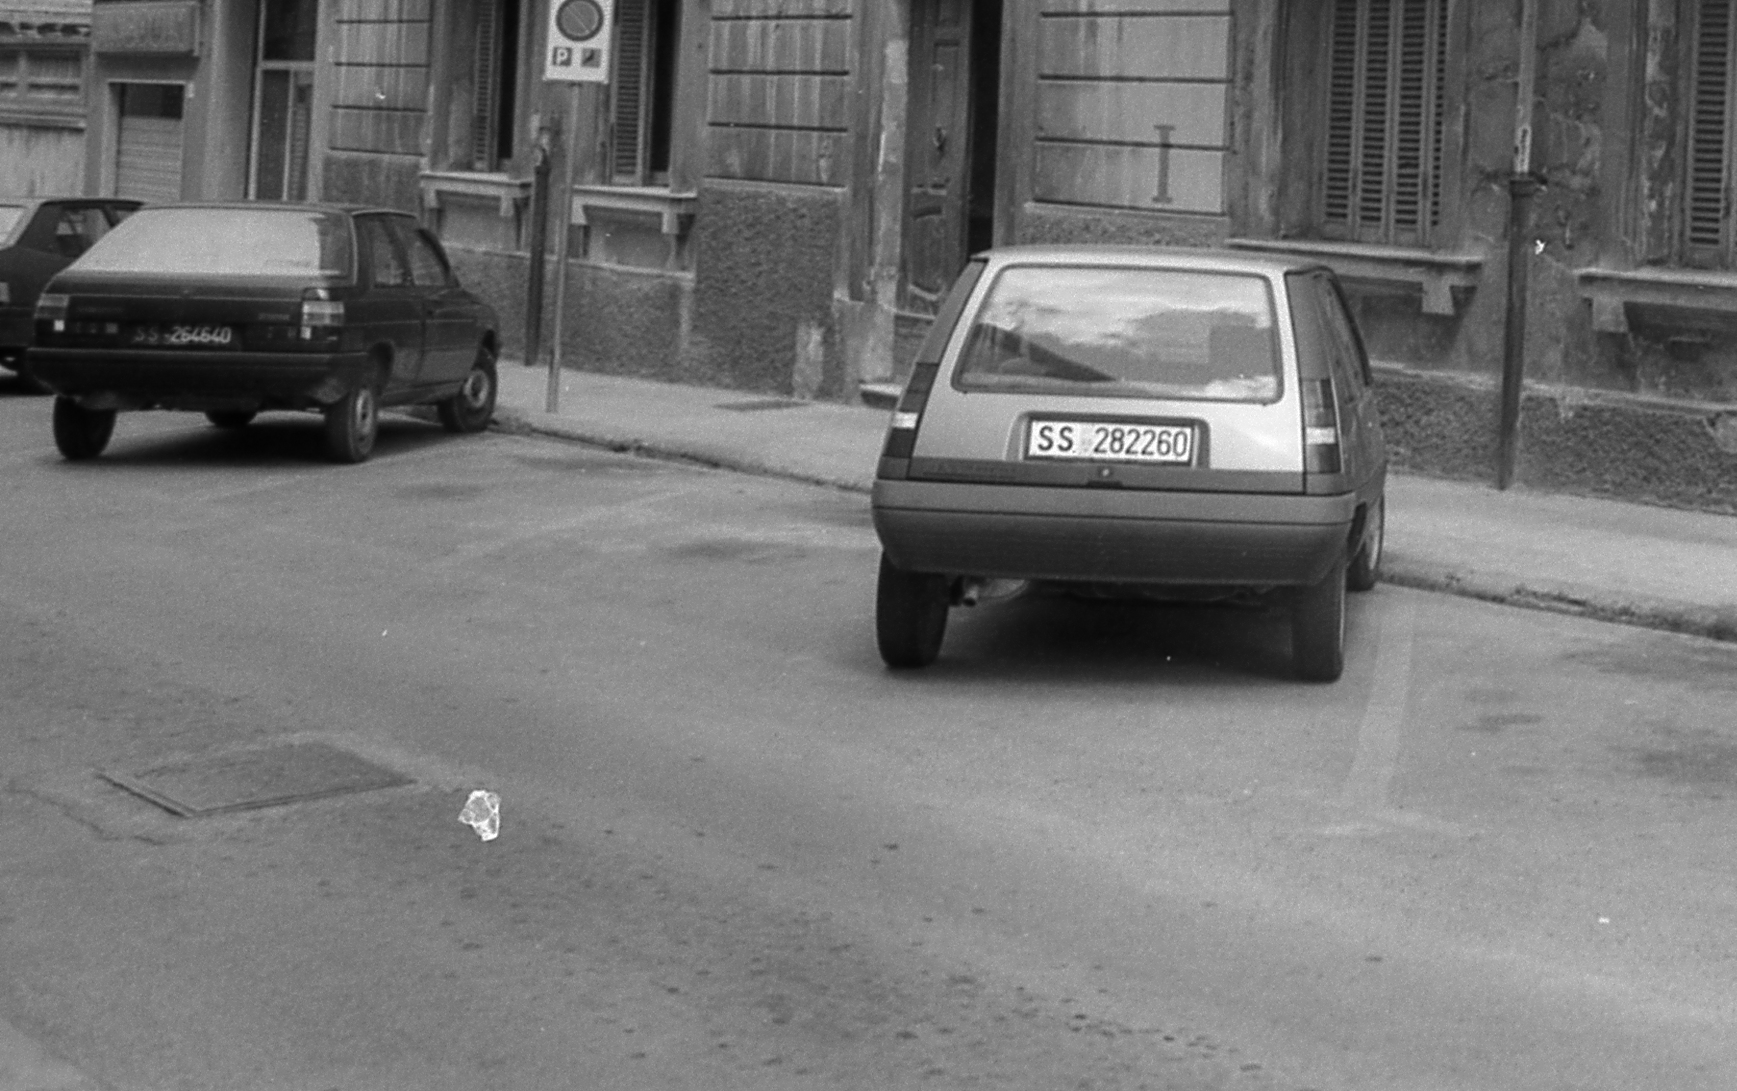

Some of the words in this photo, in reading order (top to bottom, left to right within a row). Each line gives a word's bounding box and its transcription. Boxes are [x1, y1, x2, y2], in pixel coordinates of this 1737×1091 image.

[556, 49, 568, 65] P
[134, 327, 159, 342] SS
[170, 325, 232, 344] 264640
[1037, 425, 1074, 452] SS
[1093, 427, 1188, 457] 282260
